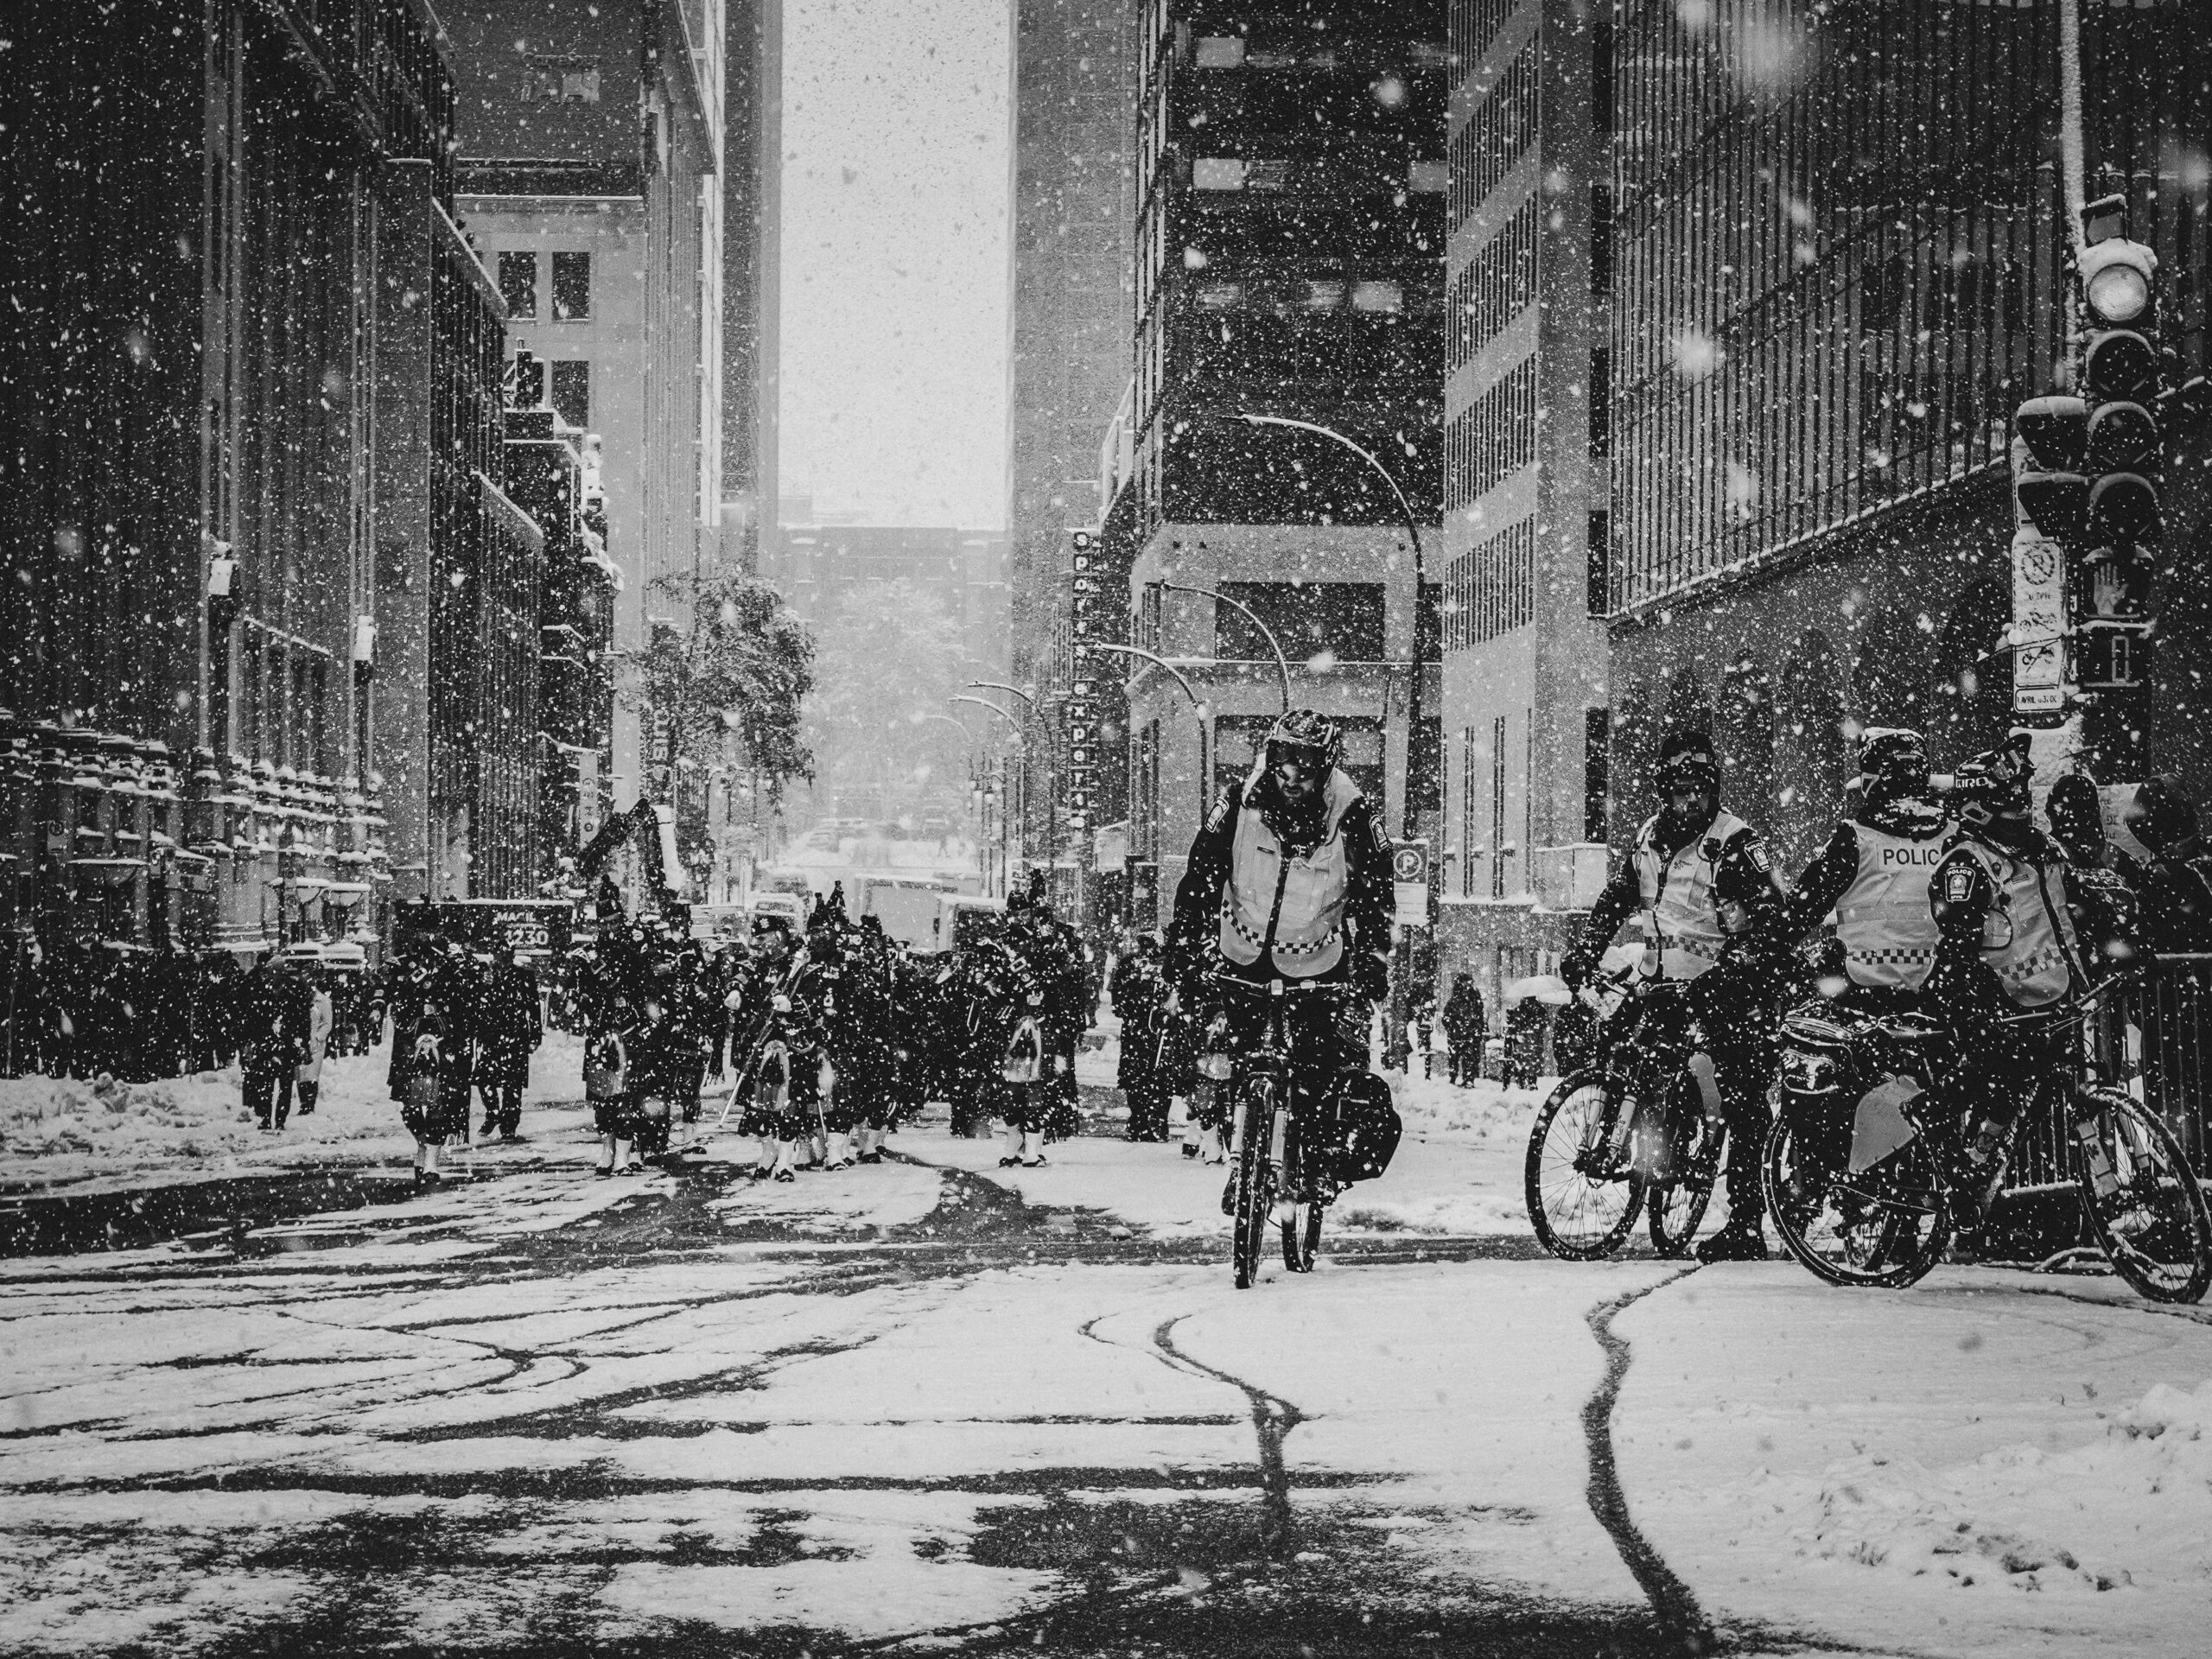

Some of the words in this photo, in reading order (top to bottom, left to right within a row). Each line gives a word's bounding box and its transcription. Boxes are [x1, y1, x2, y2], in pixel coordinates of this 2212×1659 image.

[1955, 777, 1989, 788] GIRO
[1883, 849, 1940, 865] POLIC
[504, 929, 549, 945] 1230
